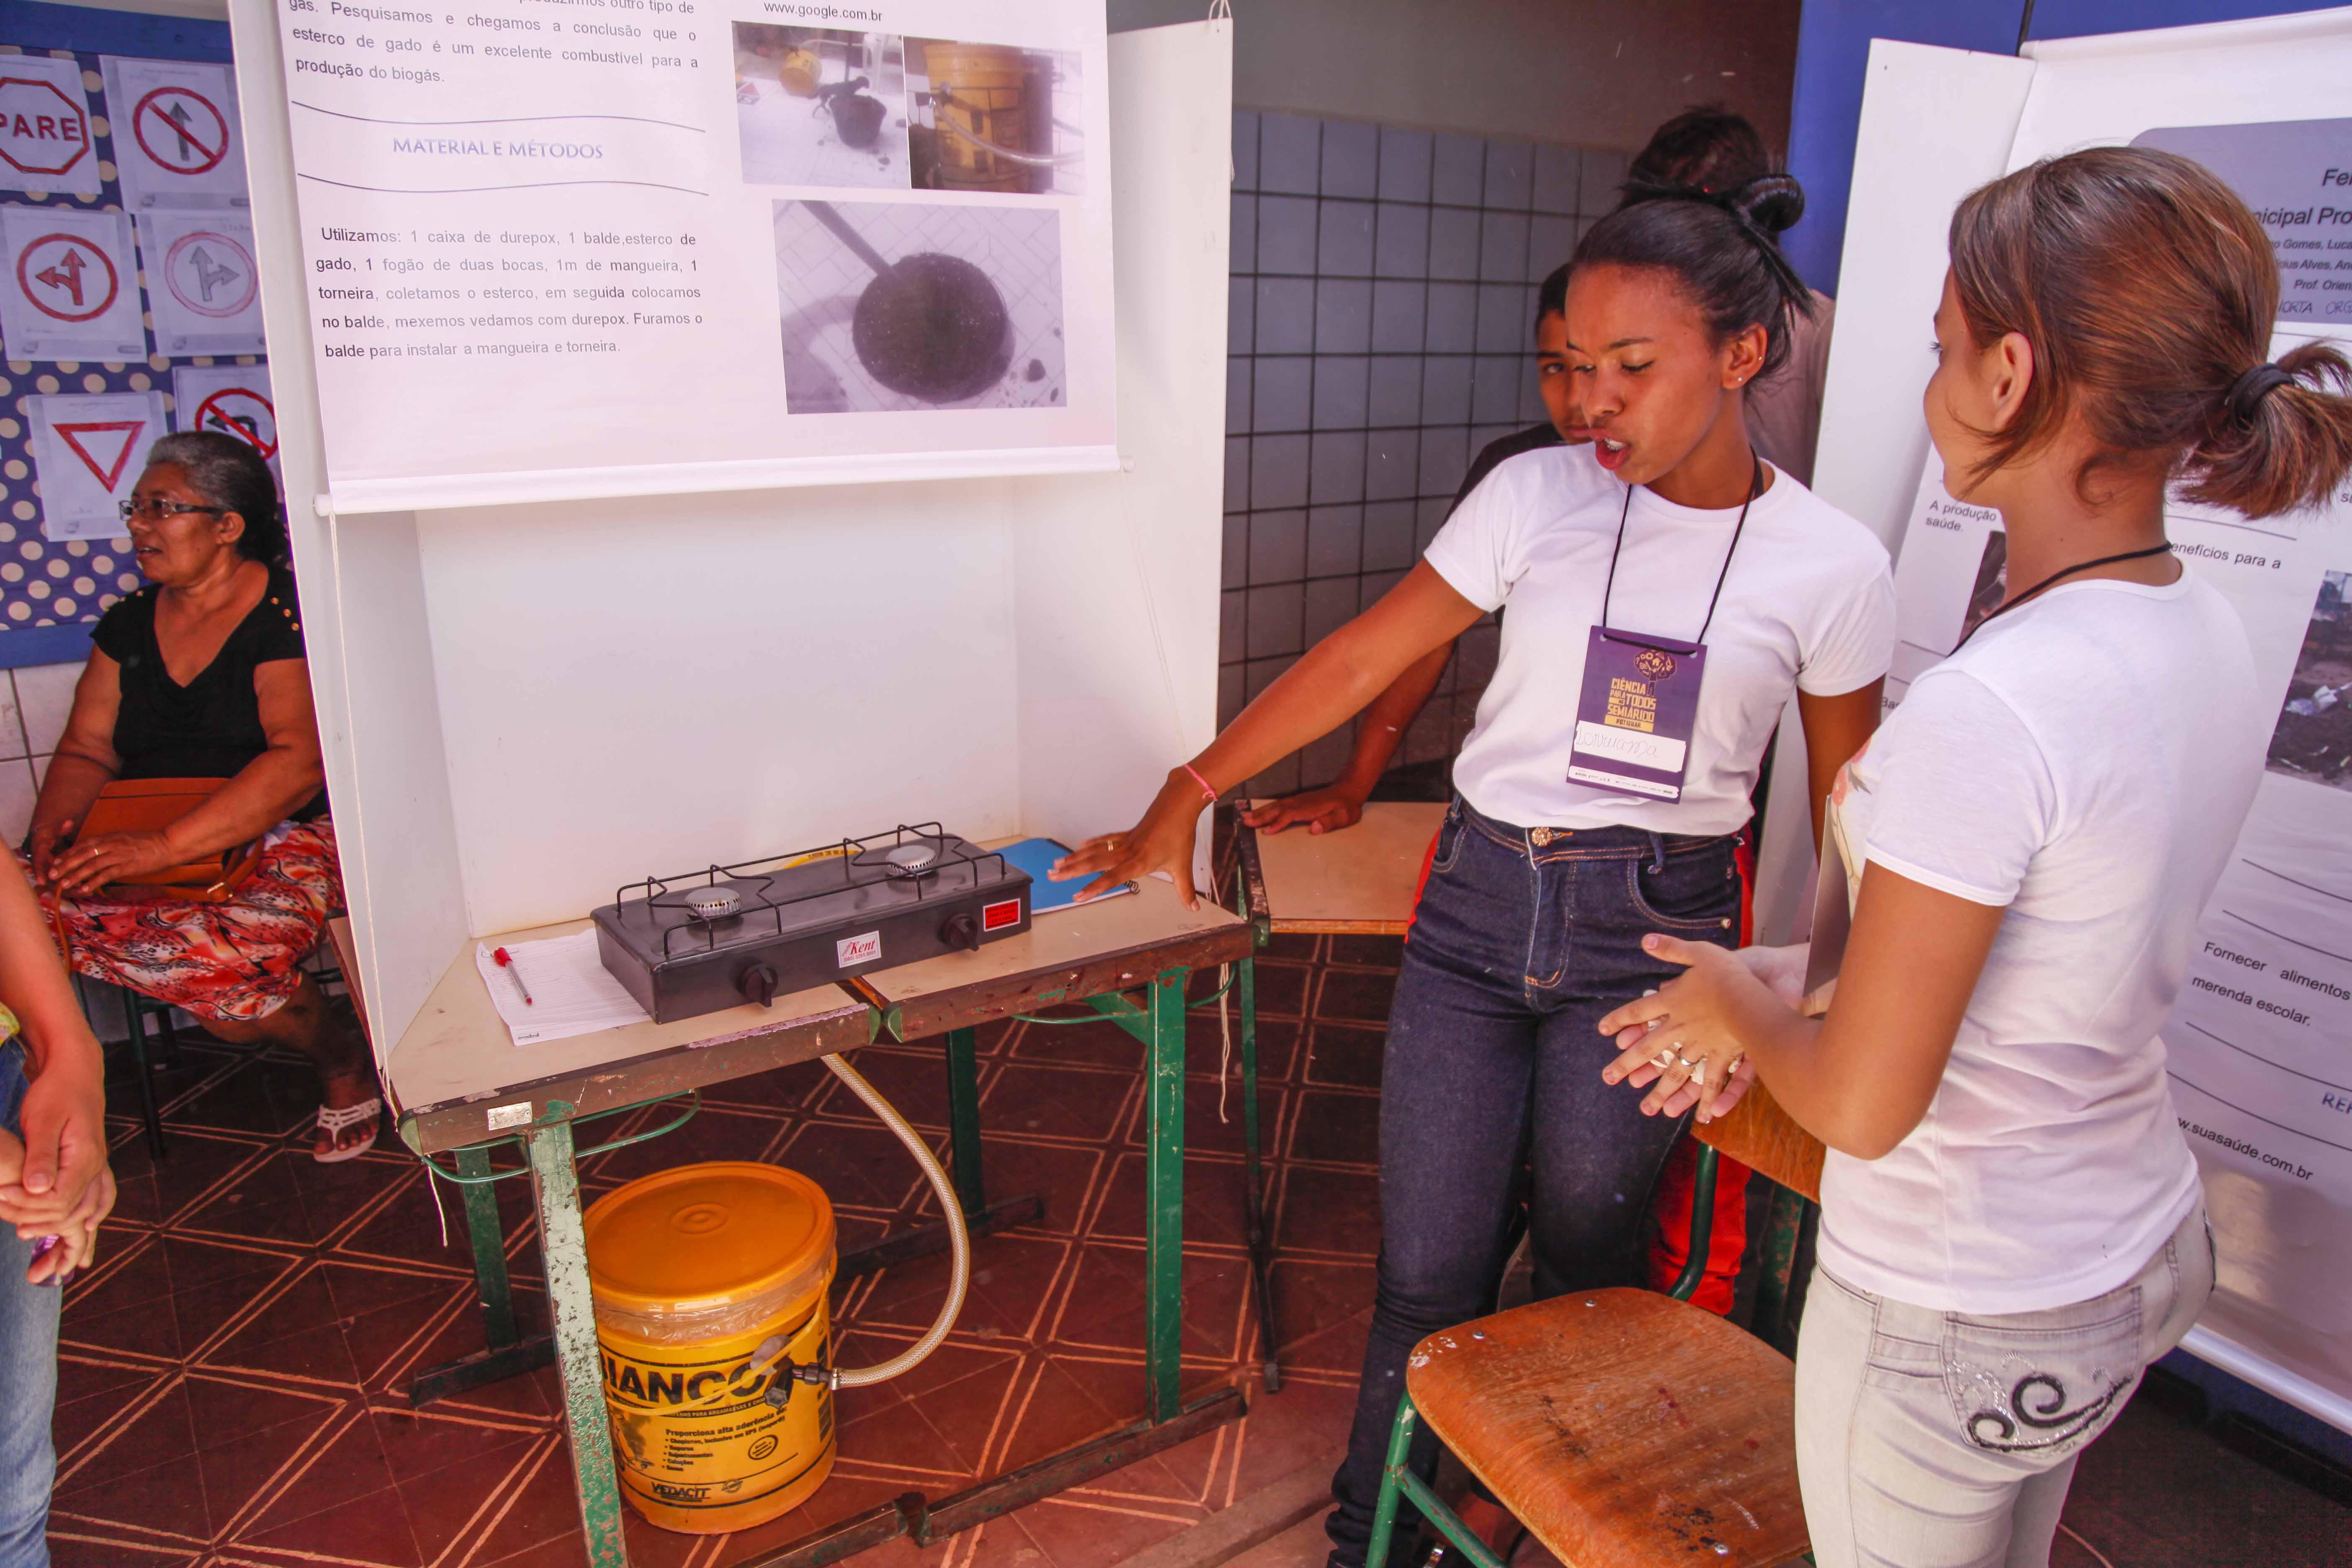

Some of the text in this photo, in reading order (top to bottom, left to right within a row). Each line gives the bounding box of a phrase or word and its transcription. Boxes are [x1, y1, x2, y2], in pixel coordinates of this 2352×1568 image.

[611, 0, 644, 10] outro
[649, 0, 673, 14] tipo
[678, 1, 694, 13] de
[764, 2, 882, 22] www.google.com.br
[330, 1, 433, 23] Pesquisamos
[446, 15, 454, 24] e
[467, 13, 541, 31] chegamos
[553, 23, 561, 32] a
[573, 22, 641, 37] conclusão
[653, 29, 677, 42] que
[689, 32, 696, 41] o
[291, 28, 698, 69] esterco de gado é um excelente combustível para a
[295, 59, 444, 84] produção do biogás.
[393, 137, 603, 159] MATERIAL E MÉTODOS
[322, 227, 696, 246] Utilizamos: 1 caixa de durepox, 1 balde,esterco de
[2283, 239, 2323, 250] Gomes,
[316, 257, 696, 274] gado, 1 fogão de duas bocas, 1m de mangueira, 1
[2300, 260, 2332, 270] Alves,
[2294, 279, 2318, 289] Prof.
[318, 286, 700, 302] torneira, coletamos o esterco, em seguida colocamos
[322, 312, 702, 330] no balde, mexemos vedamos com durepox. Furamos o
[325, 340, 620, 360] balde para instalar a mangueira e torneira.
[1926, 517, 1963, 532] saúde.
[1929, 500, 2281, 568] A produção enefícios para a
[1611, 677, 1646, 695] CIÊNCIA
[1610, 689, 1657, 710] PARA TODOS
[1607, 704, 1655, 722] SEMIÁRIDO
[1616, 719, 1641, 728] POTIGUAR
[851, 939, 875, 955] Kent
[2203, 941, 2351, 1001] Fornecer alimentos
[2192, 976, 2311, 1026] merenda escolar.
[2178, 1117, 2314, 1182] w.suasaúde.com.br
[665, 1429, 715, 1437] Proporciona
[736, 1412, 774, 1431] aderência
